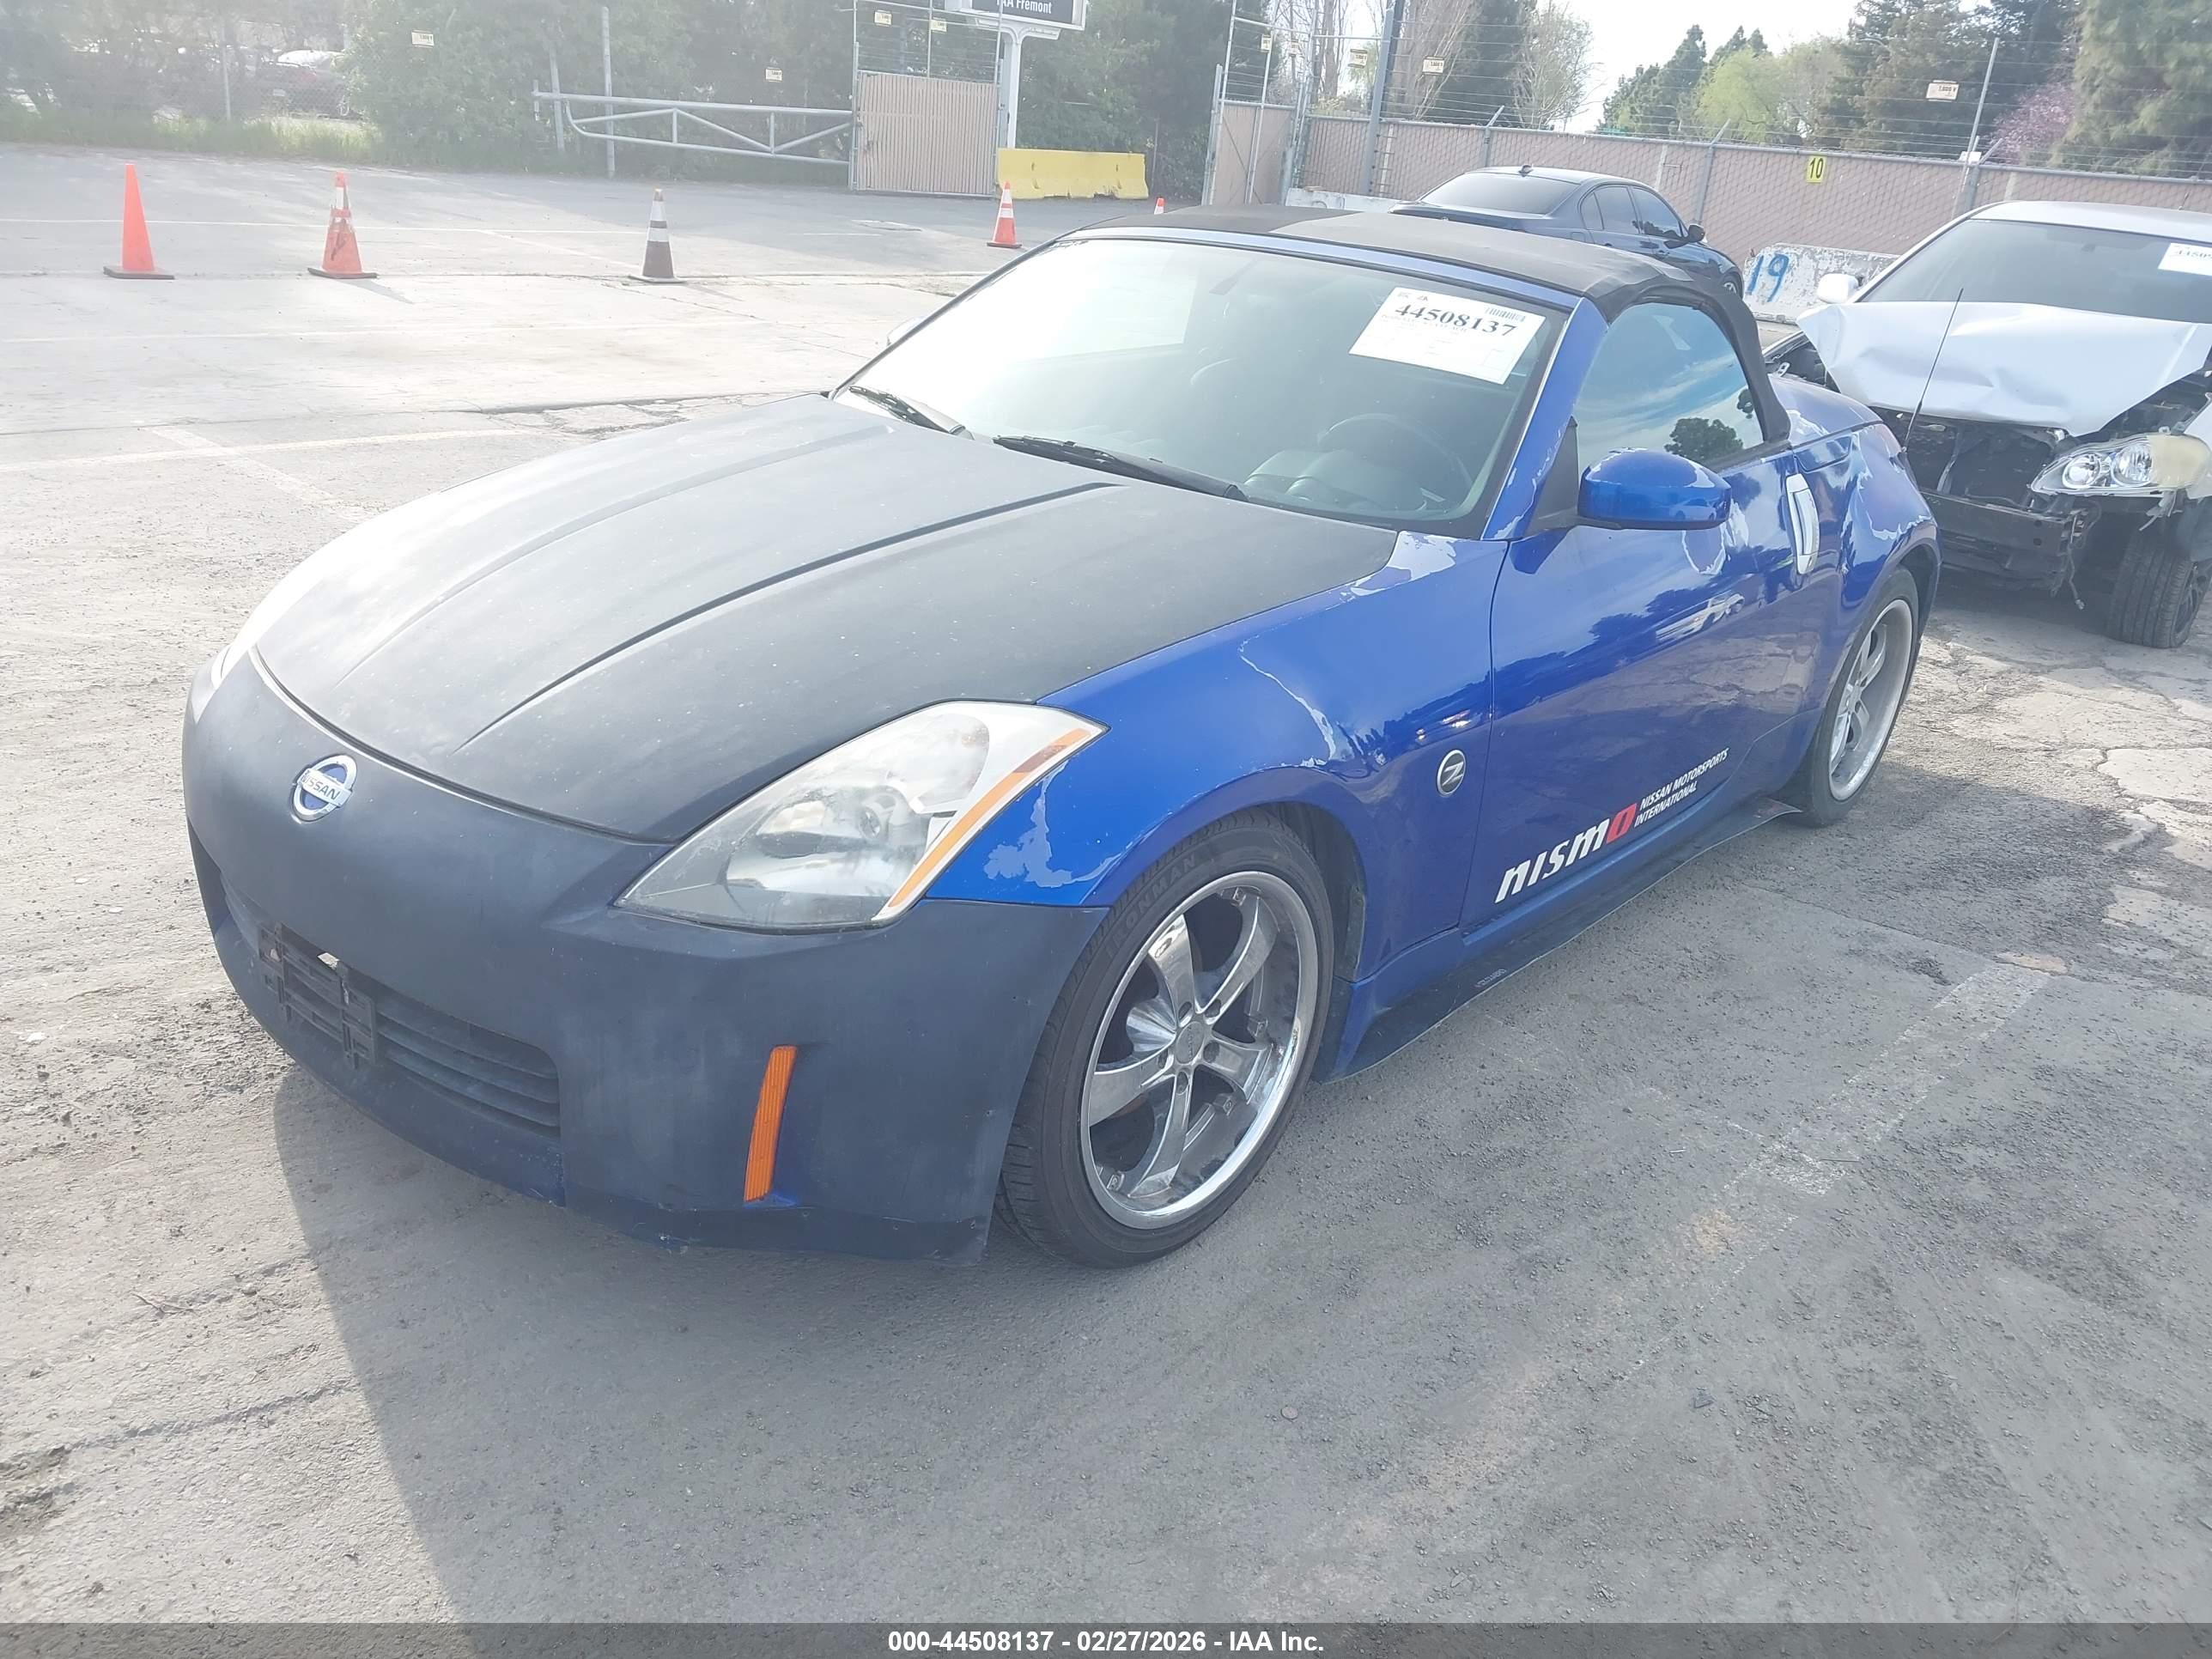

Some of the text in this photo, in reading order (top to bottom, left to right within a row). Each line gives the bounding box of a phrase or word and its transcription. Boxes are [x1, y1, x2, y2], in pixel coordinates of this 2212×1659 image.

[1016, 0, 1053, 14] Fremont
[1809, 157, 1825, 179] 10
[1745, 252, 1790, 303] 19
[1395, 303, 1518, 337] 44508137
[299, 769, 341, 800] NISSAN
[1639, 746, 1729, 811] NISSAN MOTORSPORTS
[1634, 780, 1698, 829] INTERNATIONAL
[1106, 853, 1197, 959] IRONMAN
